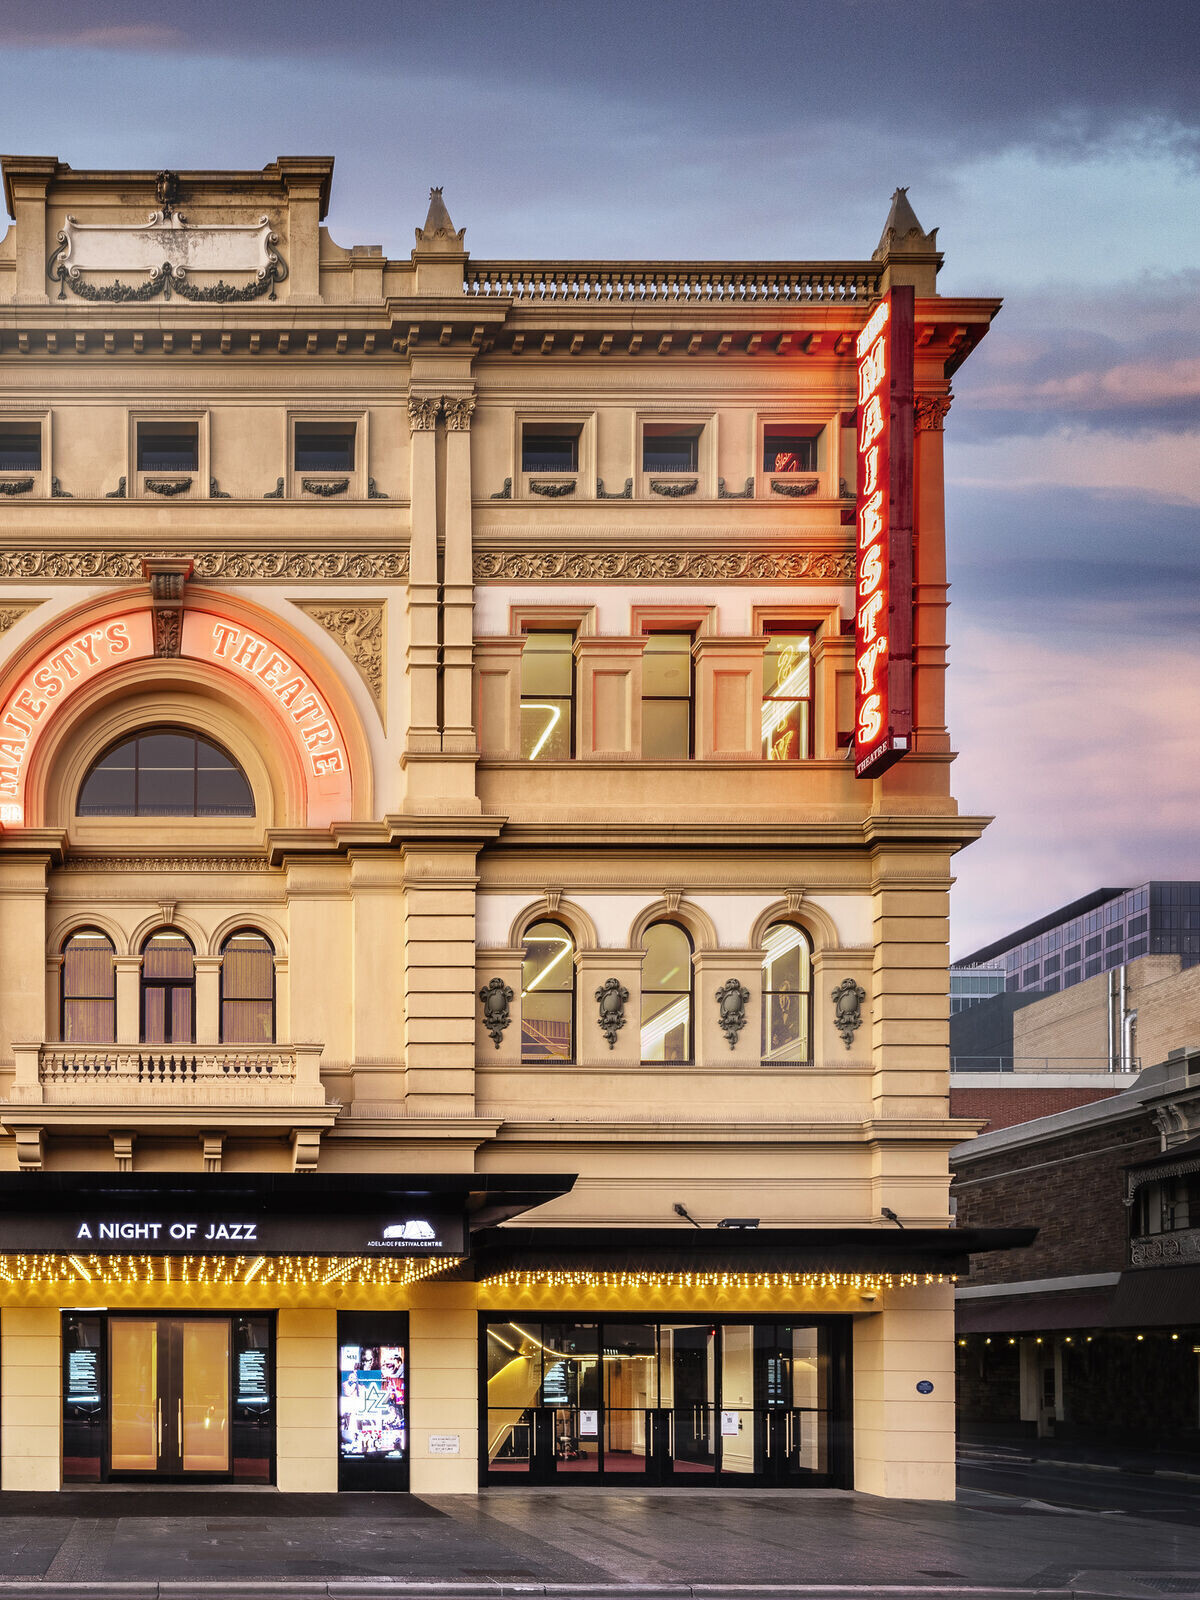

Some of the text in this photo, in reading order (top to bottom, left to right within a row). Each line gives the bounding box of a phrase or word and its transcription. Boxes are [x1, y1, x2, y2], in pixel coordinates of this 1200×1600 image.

[858, 335, 888, 745] MAJESTY'S
[211, 622, 345, 777] THEATRE
[856, 741, 888, 775] THEATRE
[76, 1222, 257, 1240] A NIGHT OF JAZZ
